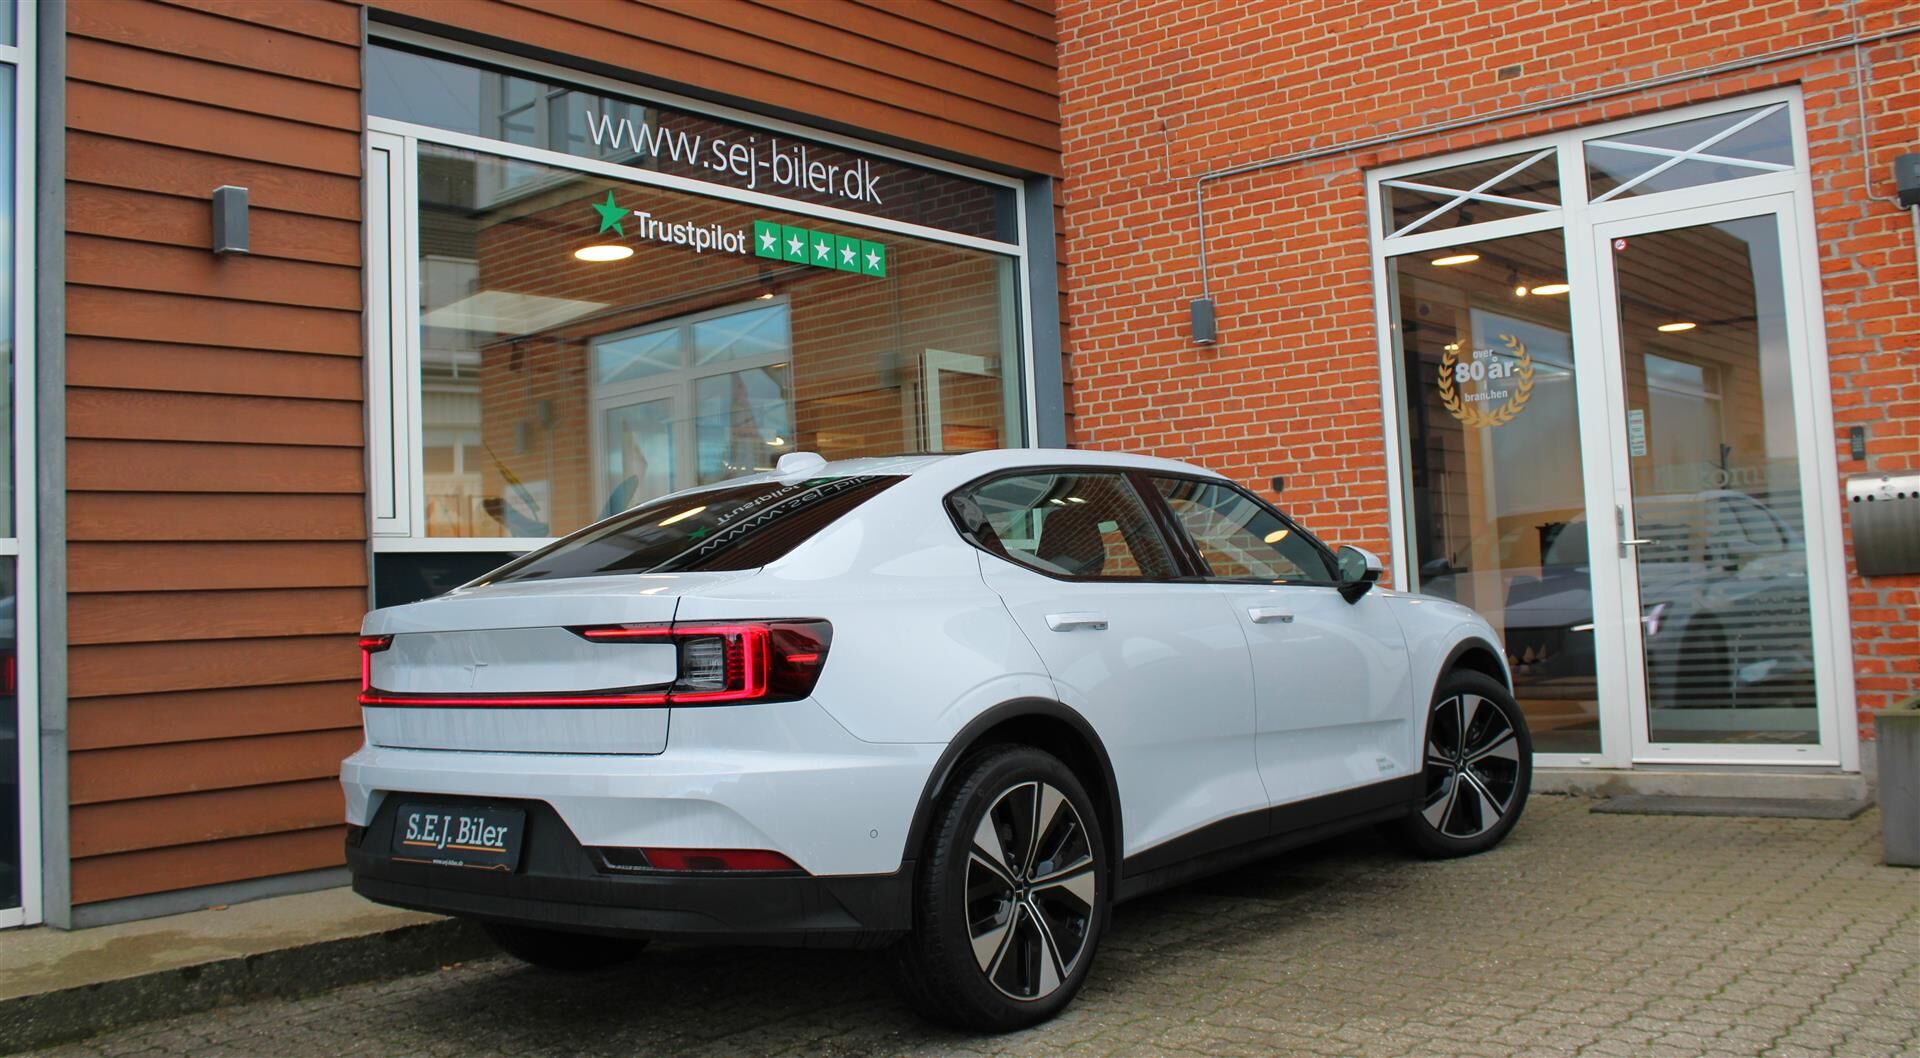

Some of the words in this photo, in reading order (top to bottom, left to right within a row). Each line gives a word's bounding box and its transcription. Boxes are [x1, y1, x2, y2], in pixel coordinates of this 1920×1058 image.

[586, 110, 883, 205] www.sej-biler.dk
[633, 210, 746, 254] Trustpilot
[1455, 361, 1485, 383] 80
[1488, 356, 1514, 379] år
[1472, 349, 1493, 359] over
[1464, 389, 1508, 402] branchen
[406, 813, 453, 850] S.E.J.
[455, 816, 508, 847] Biler
